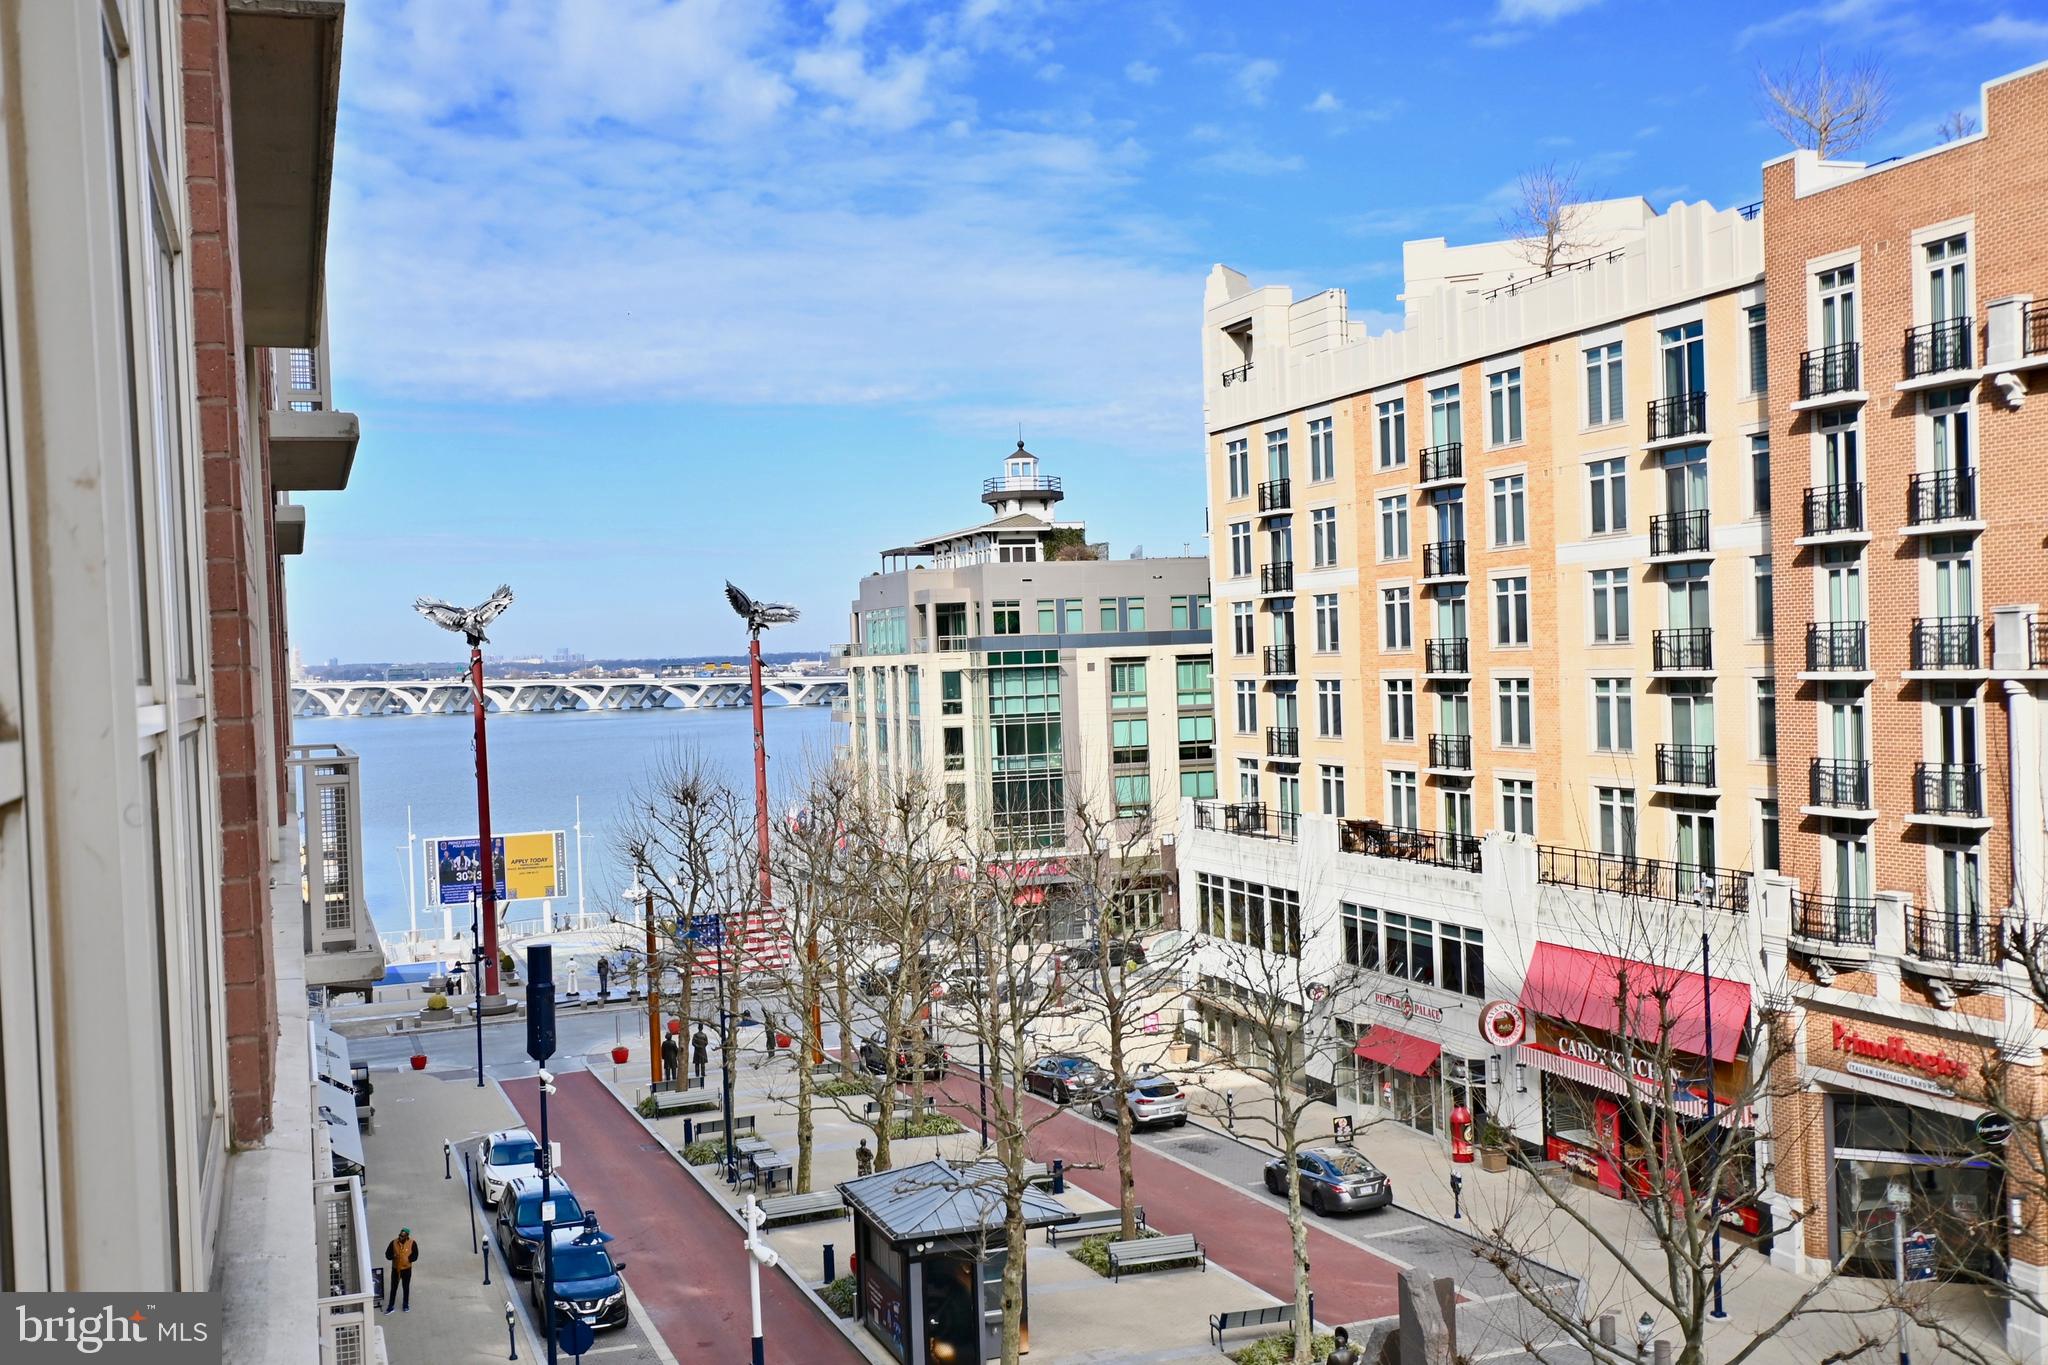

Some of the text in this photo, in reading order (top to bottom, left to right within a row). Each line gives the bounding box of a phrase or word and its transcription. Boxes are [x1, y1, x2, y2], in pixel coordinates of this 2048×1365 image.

[1375, 993, 1441, 1020] PEPPER PALACE
[1558, 1037, 1681, 1086] CANDY KTCHN
[1849, 1064, 1874, 1076] ITALIAN
[1875, 1070, 1908, 1085] SPECIALTY
